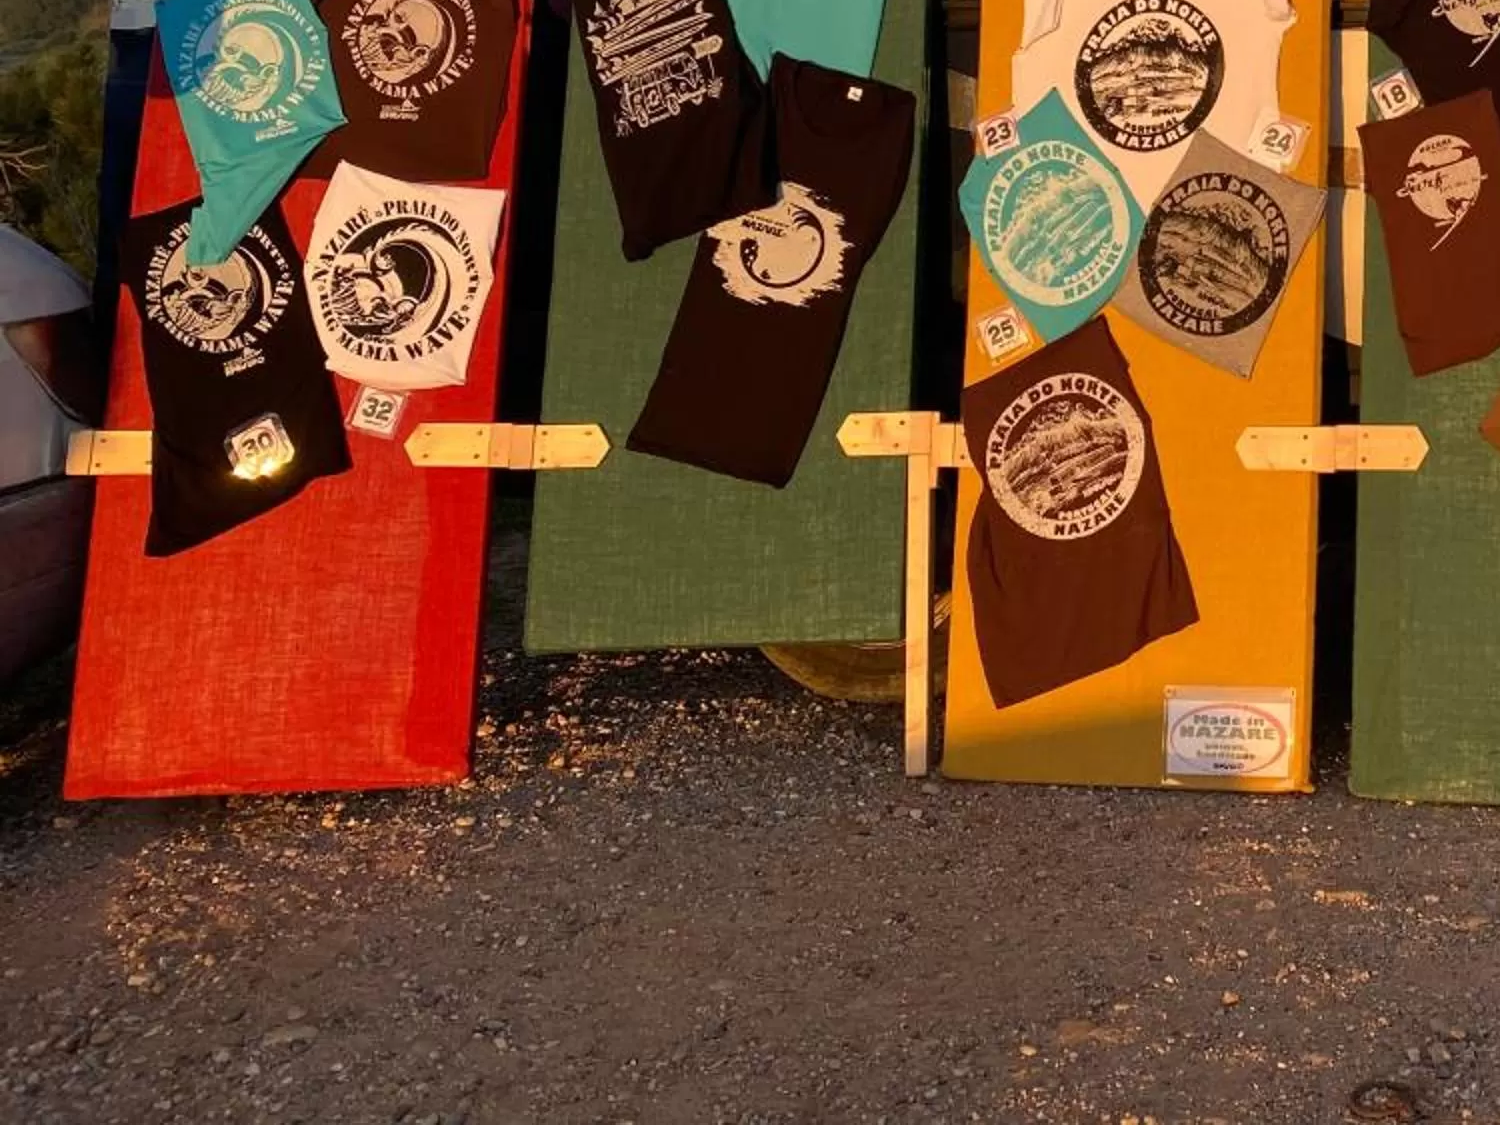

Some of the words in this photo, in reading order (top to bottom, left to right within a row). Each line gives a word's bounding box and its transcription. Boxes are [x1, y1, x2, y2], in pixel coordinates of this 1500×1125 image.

[1082, 2, 1131, 63] PRAIA
[1382, 84, 1406, 109] 18
[985, 122, 1011, 145] 23
[1263, 128, 1292, 150] 24
[985, 185, 1005, 252] PRAIA
[1005, 159, 1024, 180] DO
[1028, 144, 1087, 166] NORTE
[383, 199, 436, 219] PRAIA
[440, 207, 460, 232] DO
[1161, 176, 1223, 212] PRAIA
[1227, 179, 1253, 198] DO
[1255, 195, 1288, 259] NORTE
[200, 331, 256, 354] MAMA
[256, 279, 295, 333] WAVE
[988, 319, 1016, 345] 25
[335, 331, 398, 362] MAMA
[404, 311, 472, 360] WAVE
[362, 396, 393, 421] 32
[989, 402, 1026, 470] PRAIA
[1028, 382, 1053, 404] DO
[1060, 378, 1120, 409] NORTE
[1193, 715, 1240, 725] Made
[1247, 716, 1264, 726] in
